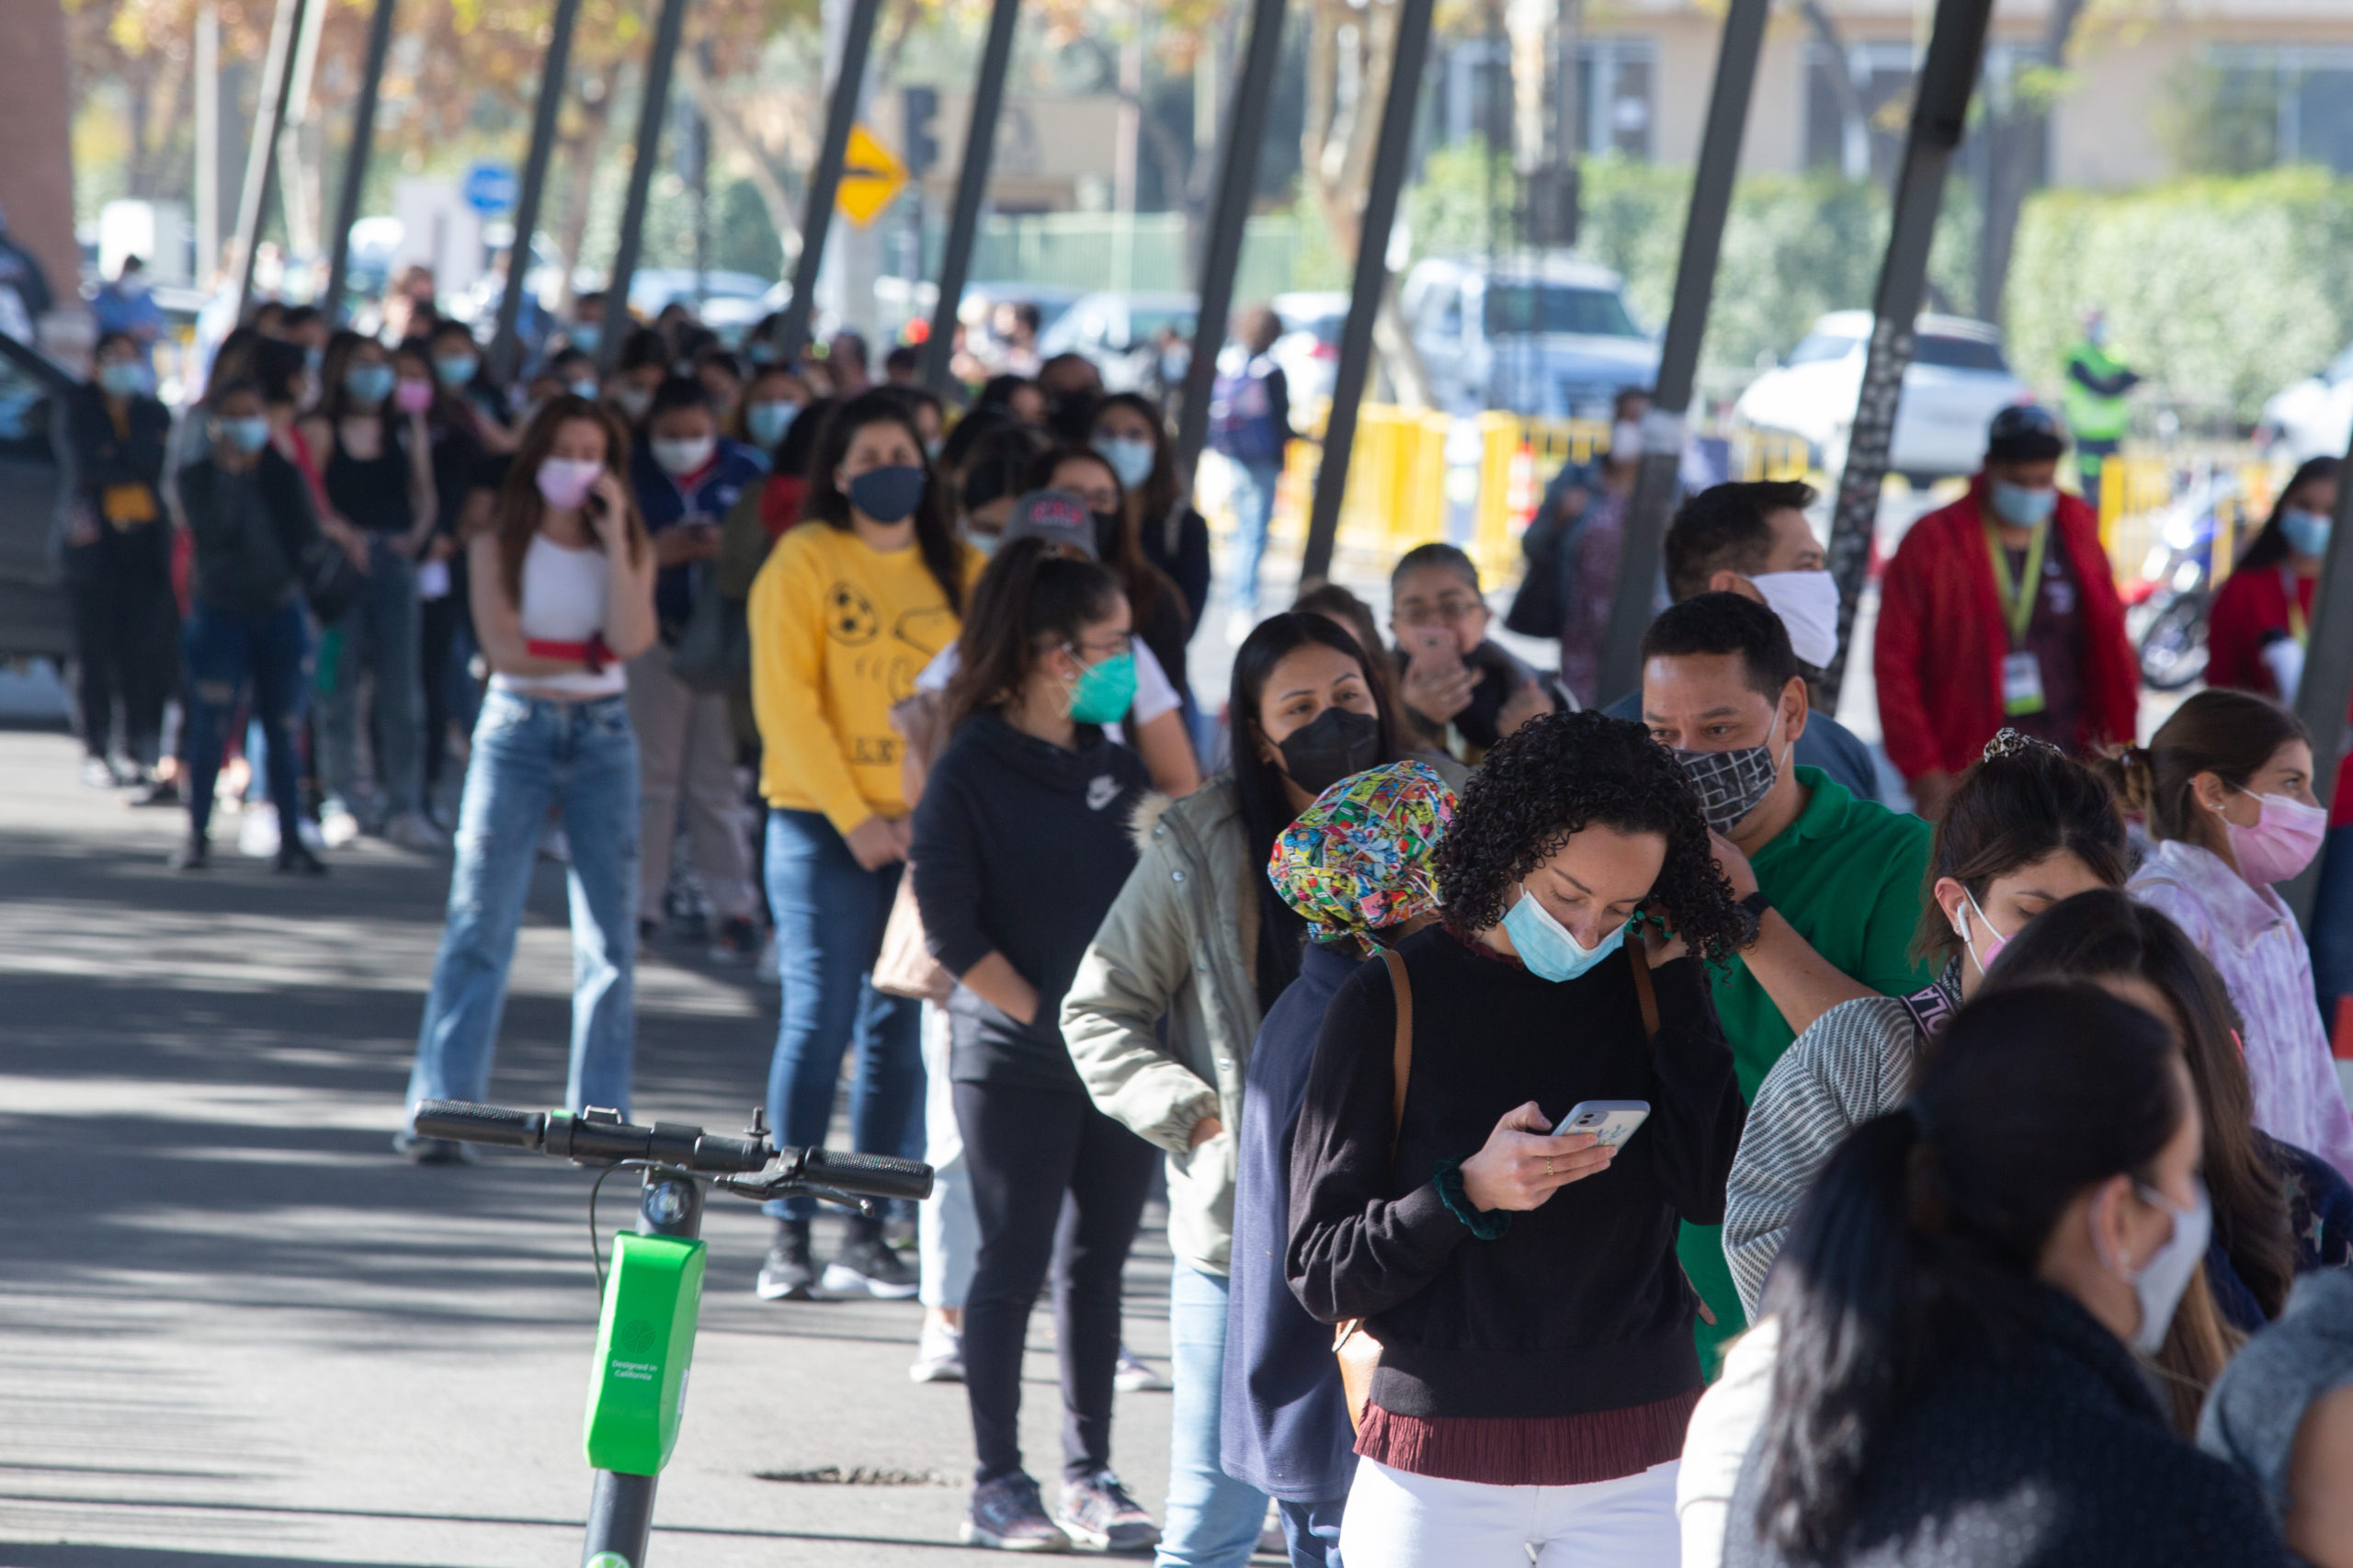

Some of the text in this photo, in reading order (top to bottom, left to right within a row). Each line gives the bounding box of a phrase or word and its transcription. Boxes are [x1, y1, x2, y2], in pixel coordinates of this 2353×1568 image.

[611, 1359, 658, 1372] Designed in
[614, 1369, 653, 1381] California
